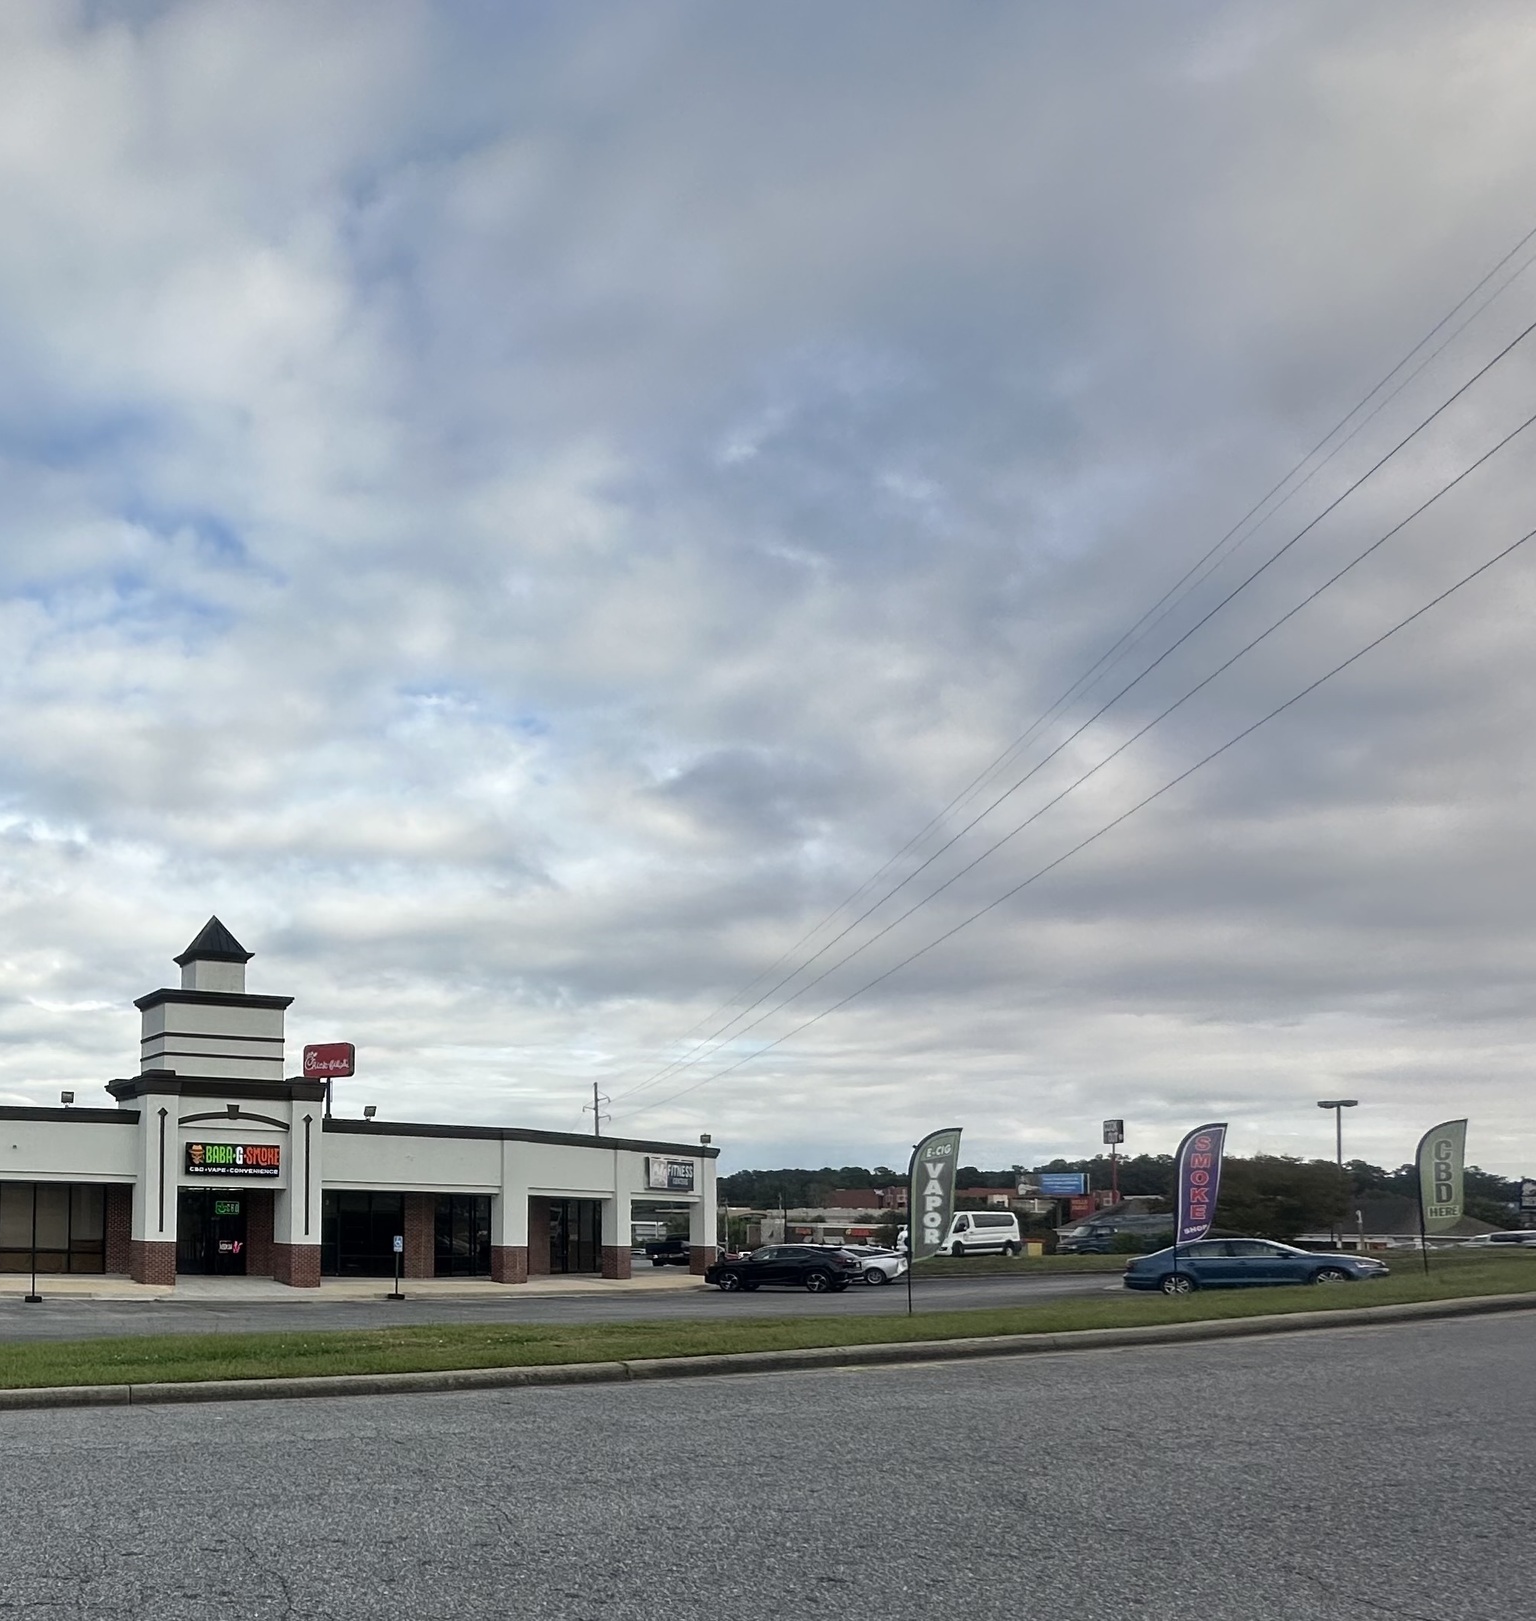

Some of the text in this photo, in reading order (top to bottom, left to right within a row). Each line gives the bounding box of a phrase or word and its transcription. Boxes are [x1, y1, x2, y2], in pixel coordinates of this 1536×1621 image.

[926, 1144, 951, 1158] E-CIG
[667, 1164, 693, 1178] FITNESS
[1190, 1135, 1212, 1220] SMOKE
[1434, 1139, 1453, 1204] CBD
[923, 1162, 945, 1244] VAPOR
[1429, 1207, 1458, 1217] HERE
[1184, 1223, 1208, 1235] SHOP
